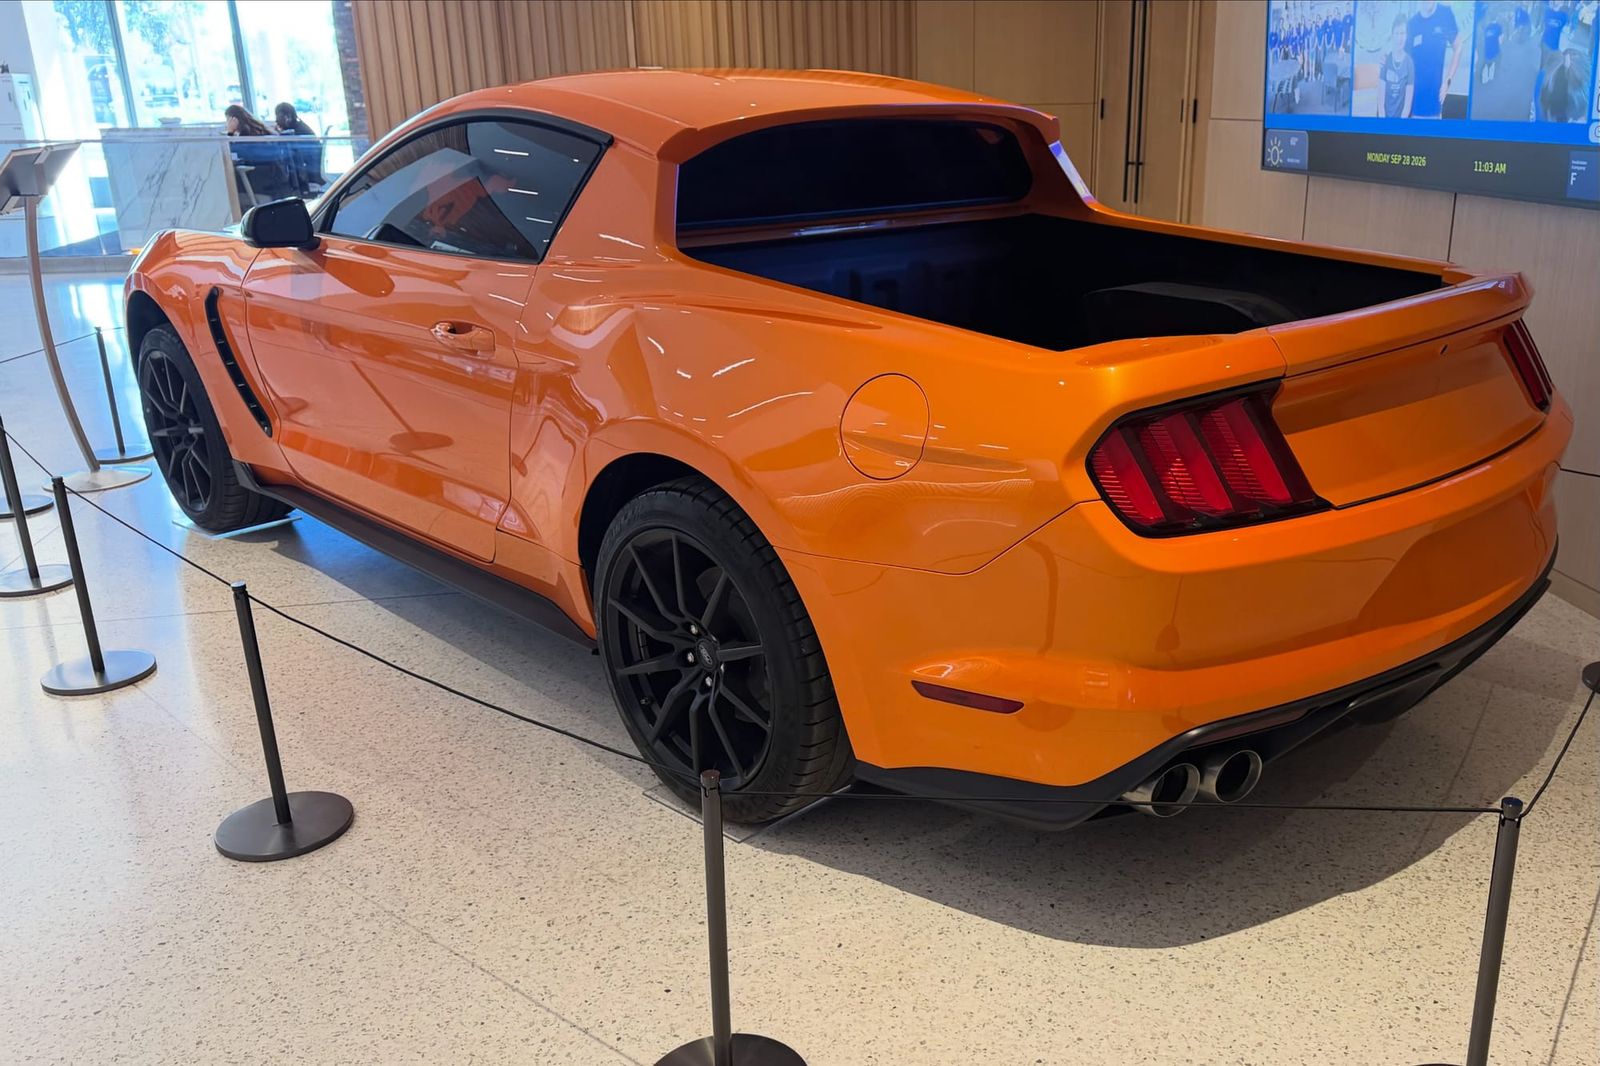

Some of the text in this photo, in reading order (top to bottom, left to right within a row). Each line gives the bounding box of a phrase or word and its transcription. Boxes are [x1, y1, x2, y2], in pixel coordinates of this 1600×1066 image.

[1366, 152, 1427, 167] MONDAY SEP 28 2026
[1473, 160, 1507, 175] 11:03 AM
